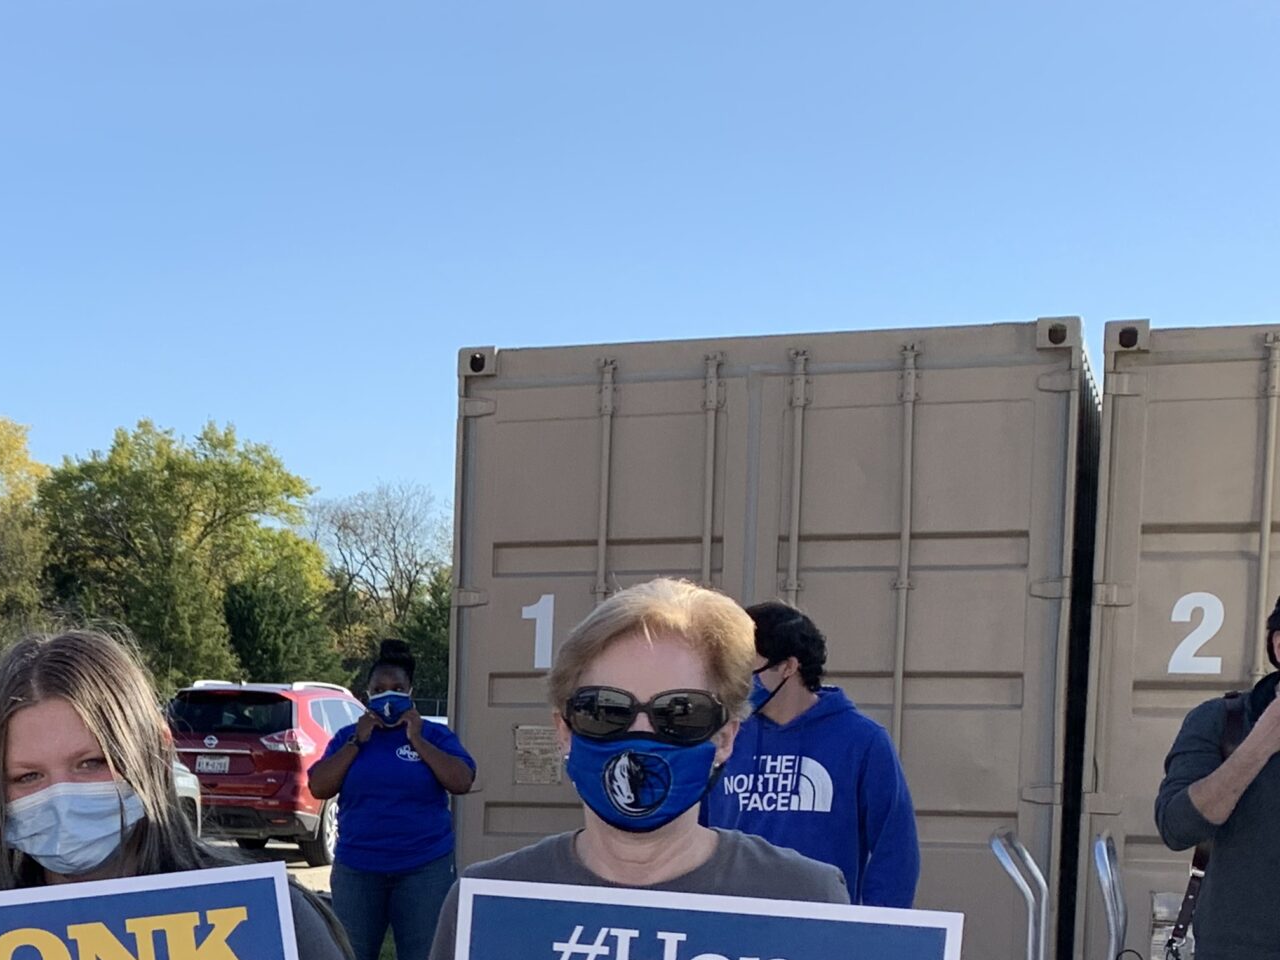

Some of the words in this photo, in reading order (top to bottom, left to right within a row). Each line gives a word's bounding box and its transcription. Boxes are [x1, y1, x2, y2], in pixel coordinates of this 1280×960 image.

[522, 594, 554, 668] 1
[1168, 592, 1224, 674] 2
[753, 755, 795, 773] THE
[724, 774, 793, 795] NORTH
[738, 793, 791, 811] FACE
